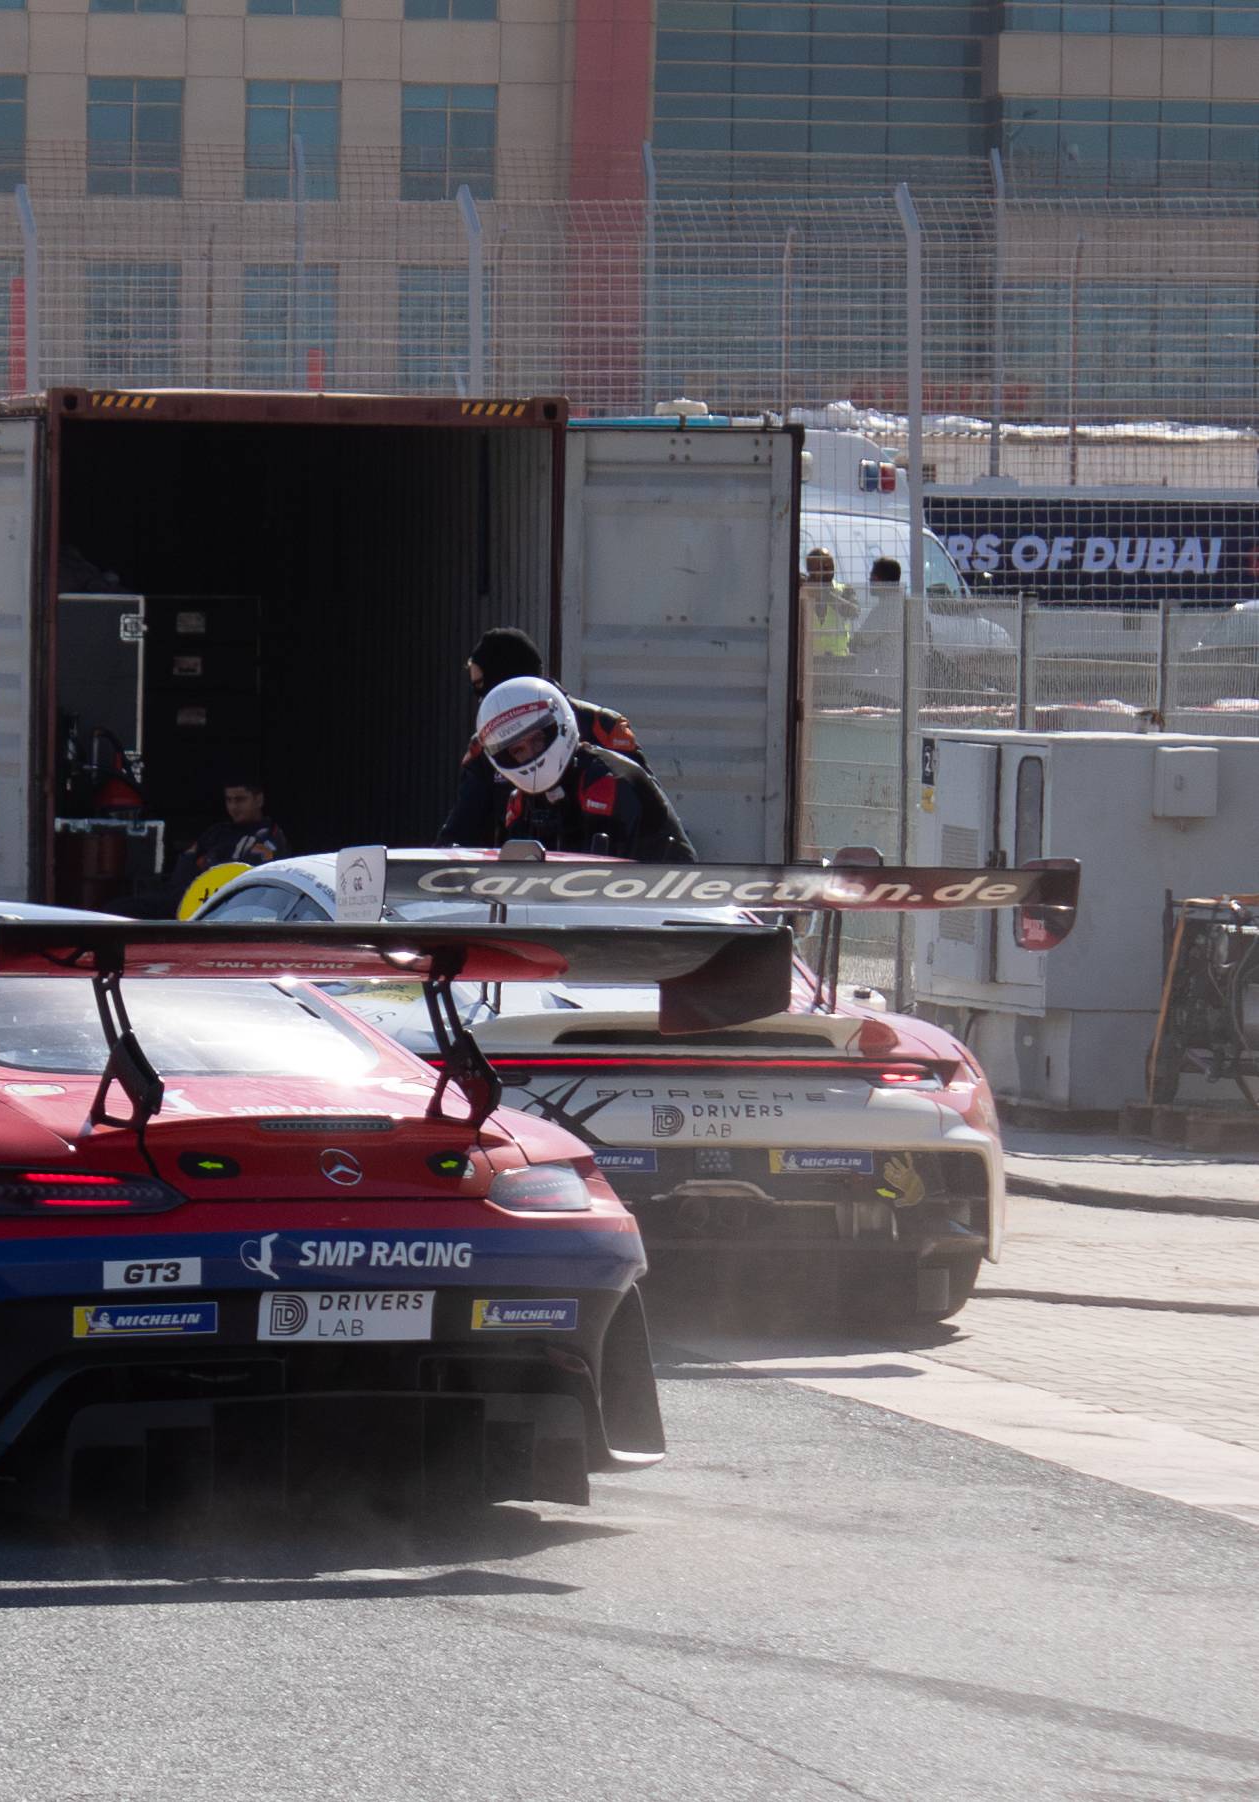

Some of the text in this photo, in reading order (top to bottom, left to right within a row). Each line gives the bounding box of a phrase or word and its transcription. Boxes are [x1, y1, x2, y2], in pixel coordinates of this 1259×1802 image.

[939, 534, 1223, 574] RS OF DUBAI
[596, 1088, 827, 1102] PORSCHE
[692, 1103, 784, 1119] DRIVERS
[692, 1123, 733, 1138] LAB
[593, 1156, 644, 1165] CHELIN
[800, 1157, 862, 1167] MICHELIN
[298, 1241, 473, 1268] SMP RACING
[124, 1262, 181, 1284] GT3
[318, 1293, 424, 1311] DRIVERS
[115, 1313, 202, 1327] MICHELIN
[503, 1309, 567, 1321] MICHELIN
[317, 1319, 365, 1337] LAB
